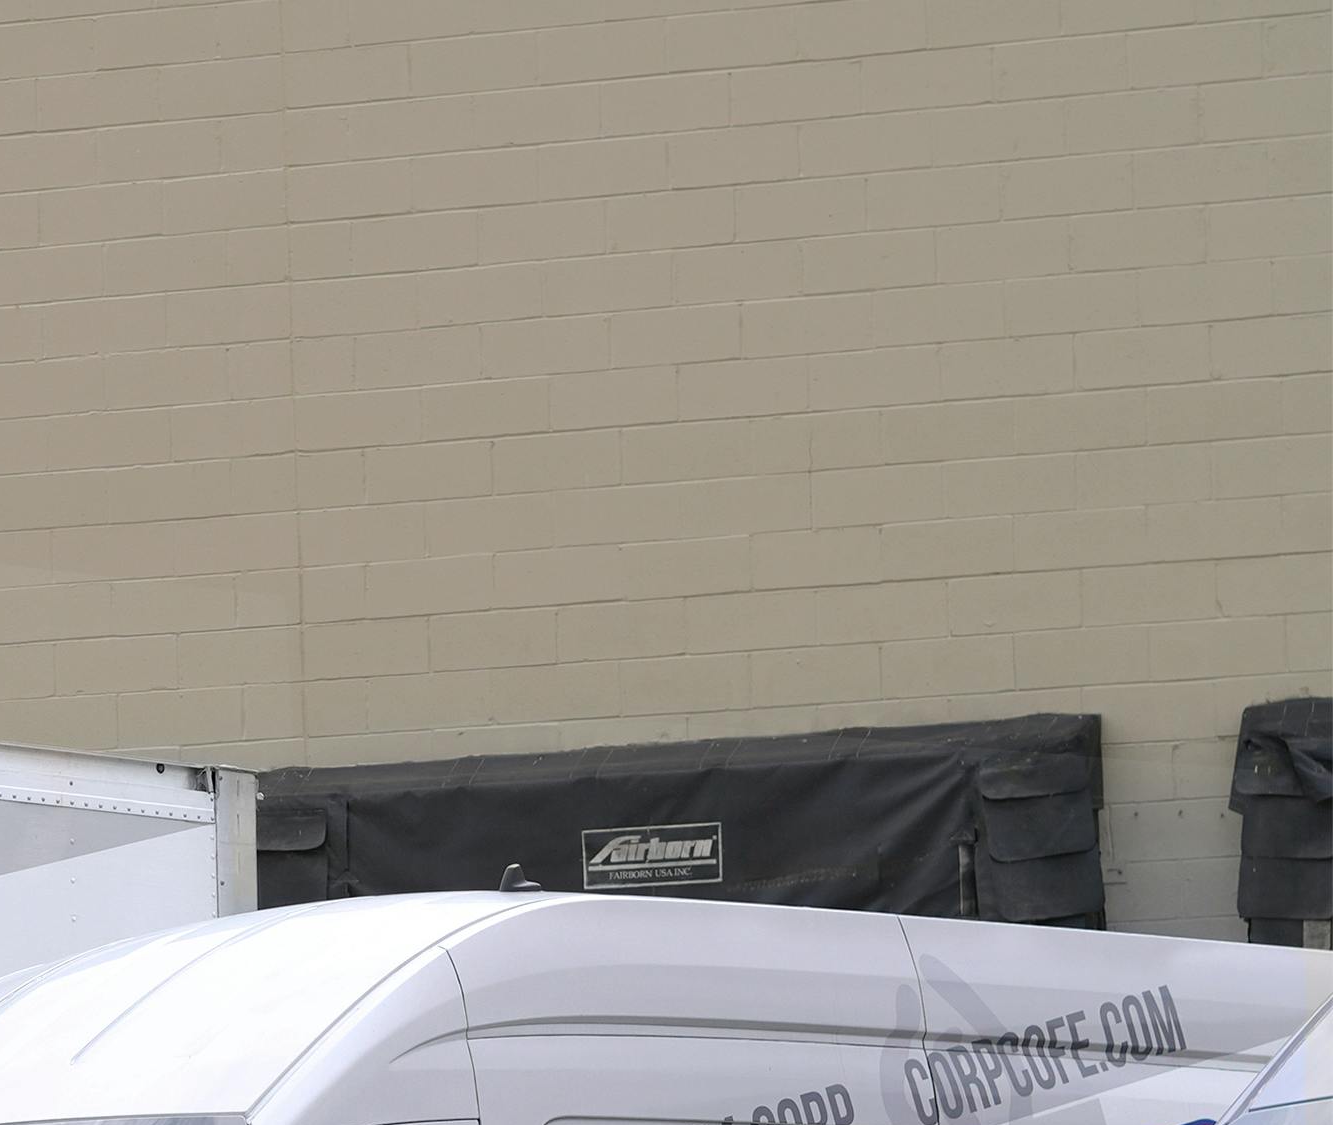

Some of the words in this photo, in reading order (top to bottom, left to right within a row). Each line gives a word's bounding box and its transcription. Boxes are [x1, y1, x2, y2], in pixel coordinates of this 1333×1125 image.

[589, 835, 713, 864] Fairborn
[609, 869, 653, 880] FAIRBORN
[654, 868, 673, 878] USA
